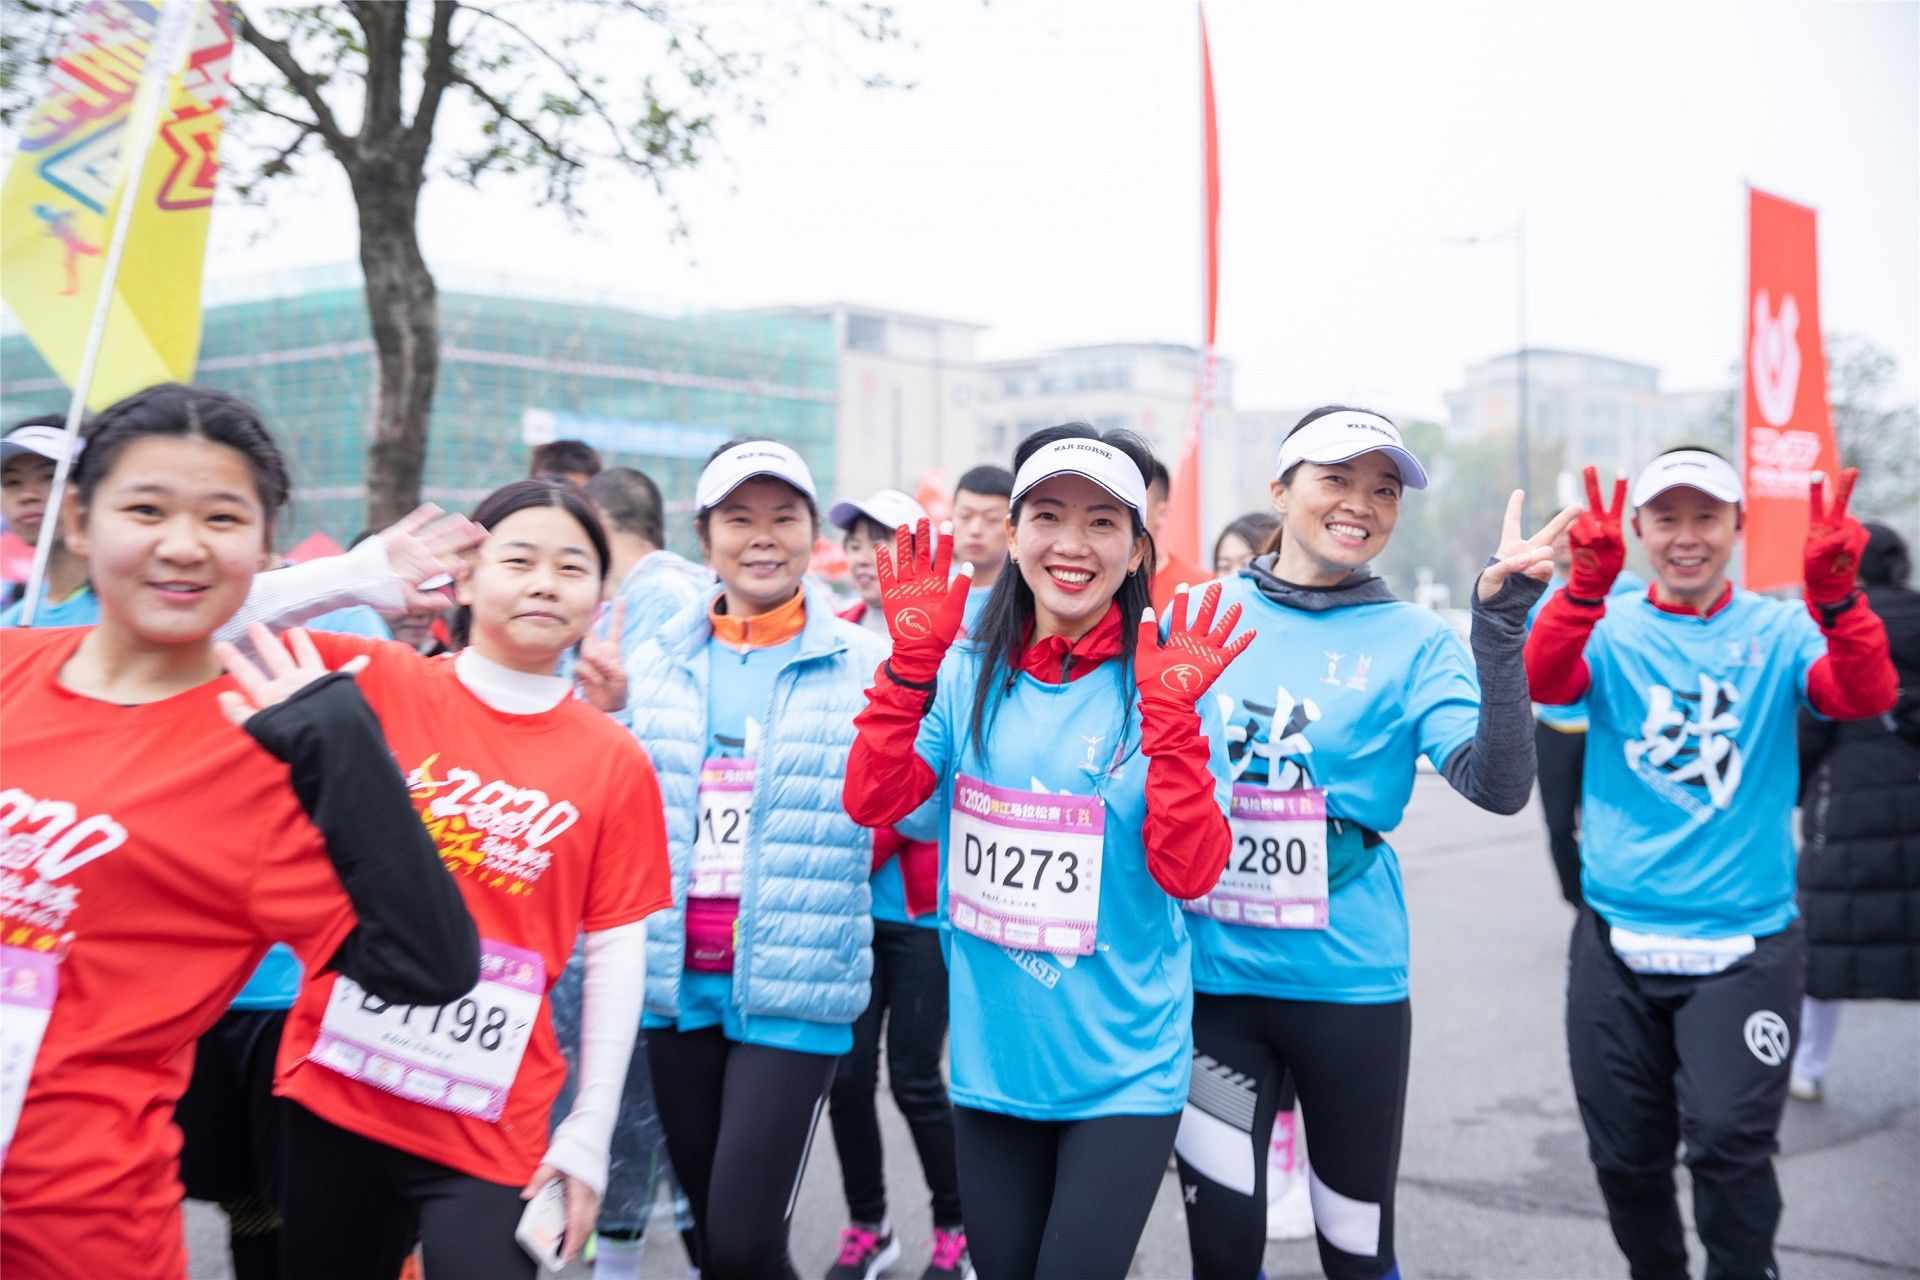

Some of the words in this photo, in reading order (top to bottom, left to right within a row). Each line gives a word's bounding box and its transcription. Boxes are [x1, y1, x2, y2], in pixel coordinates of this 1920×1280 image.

[1054, 444, 1074, 452] WAR
[1076, 444, 1112, 460] HORSE
[693, 808, 751, 846] 12
[965, 833, 1079, 894] D1273
[1226, 836, 1306, 875] 280
